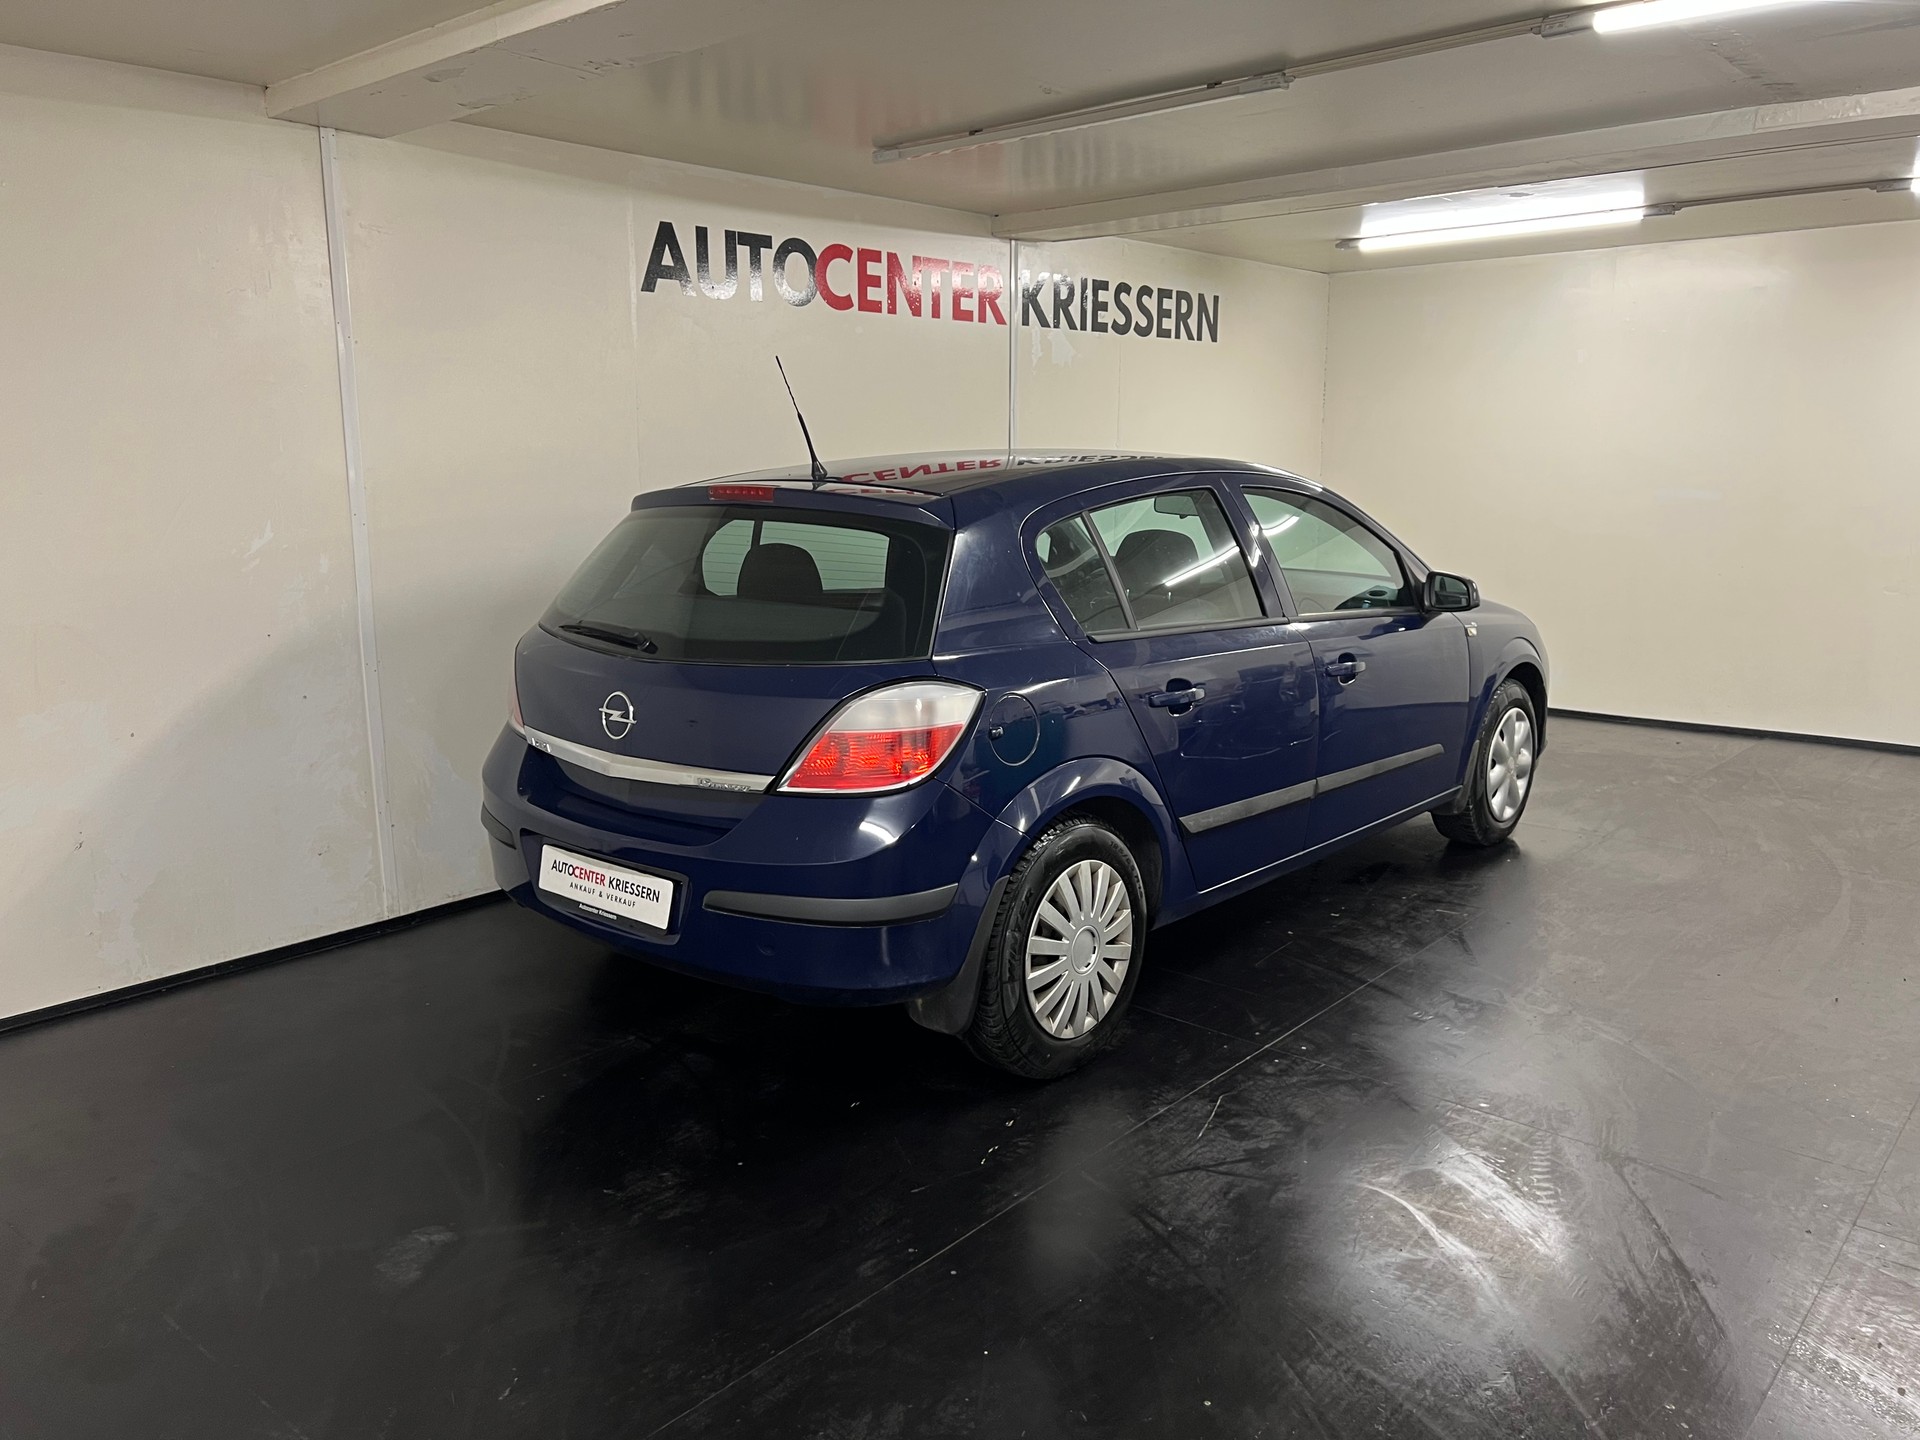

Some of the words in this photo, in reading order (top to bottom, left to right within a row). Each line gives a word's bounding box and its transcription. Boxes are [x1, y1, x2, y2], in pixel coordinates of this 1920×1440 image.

[640, 220, 1008, 326] AUTOCENTER
[1021, 269, 1220, 343] KRIESSERN
[551, 859, 606, 886] AUTOCENTER
[608, 876, 661, 903] KRIESSERN
[569, 881, 596, 896] ANKAUF
[598, 890, 603, 898] &
[606, 893, 636, 908] VERKAUF
